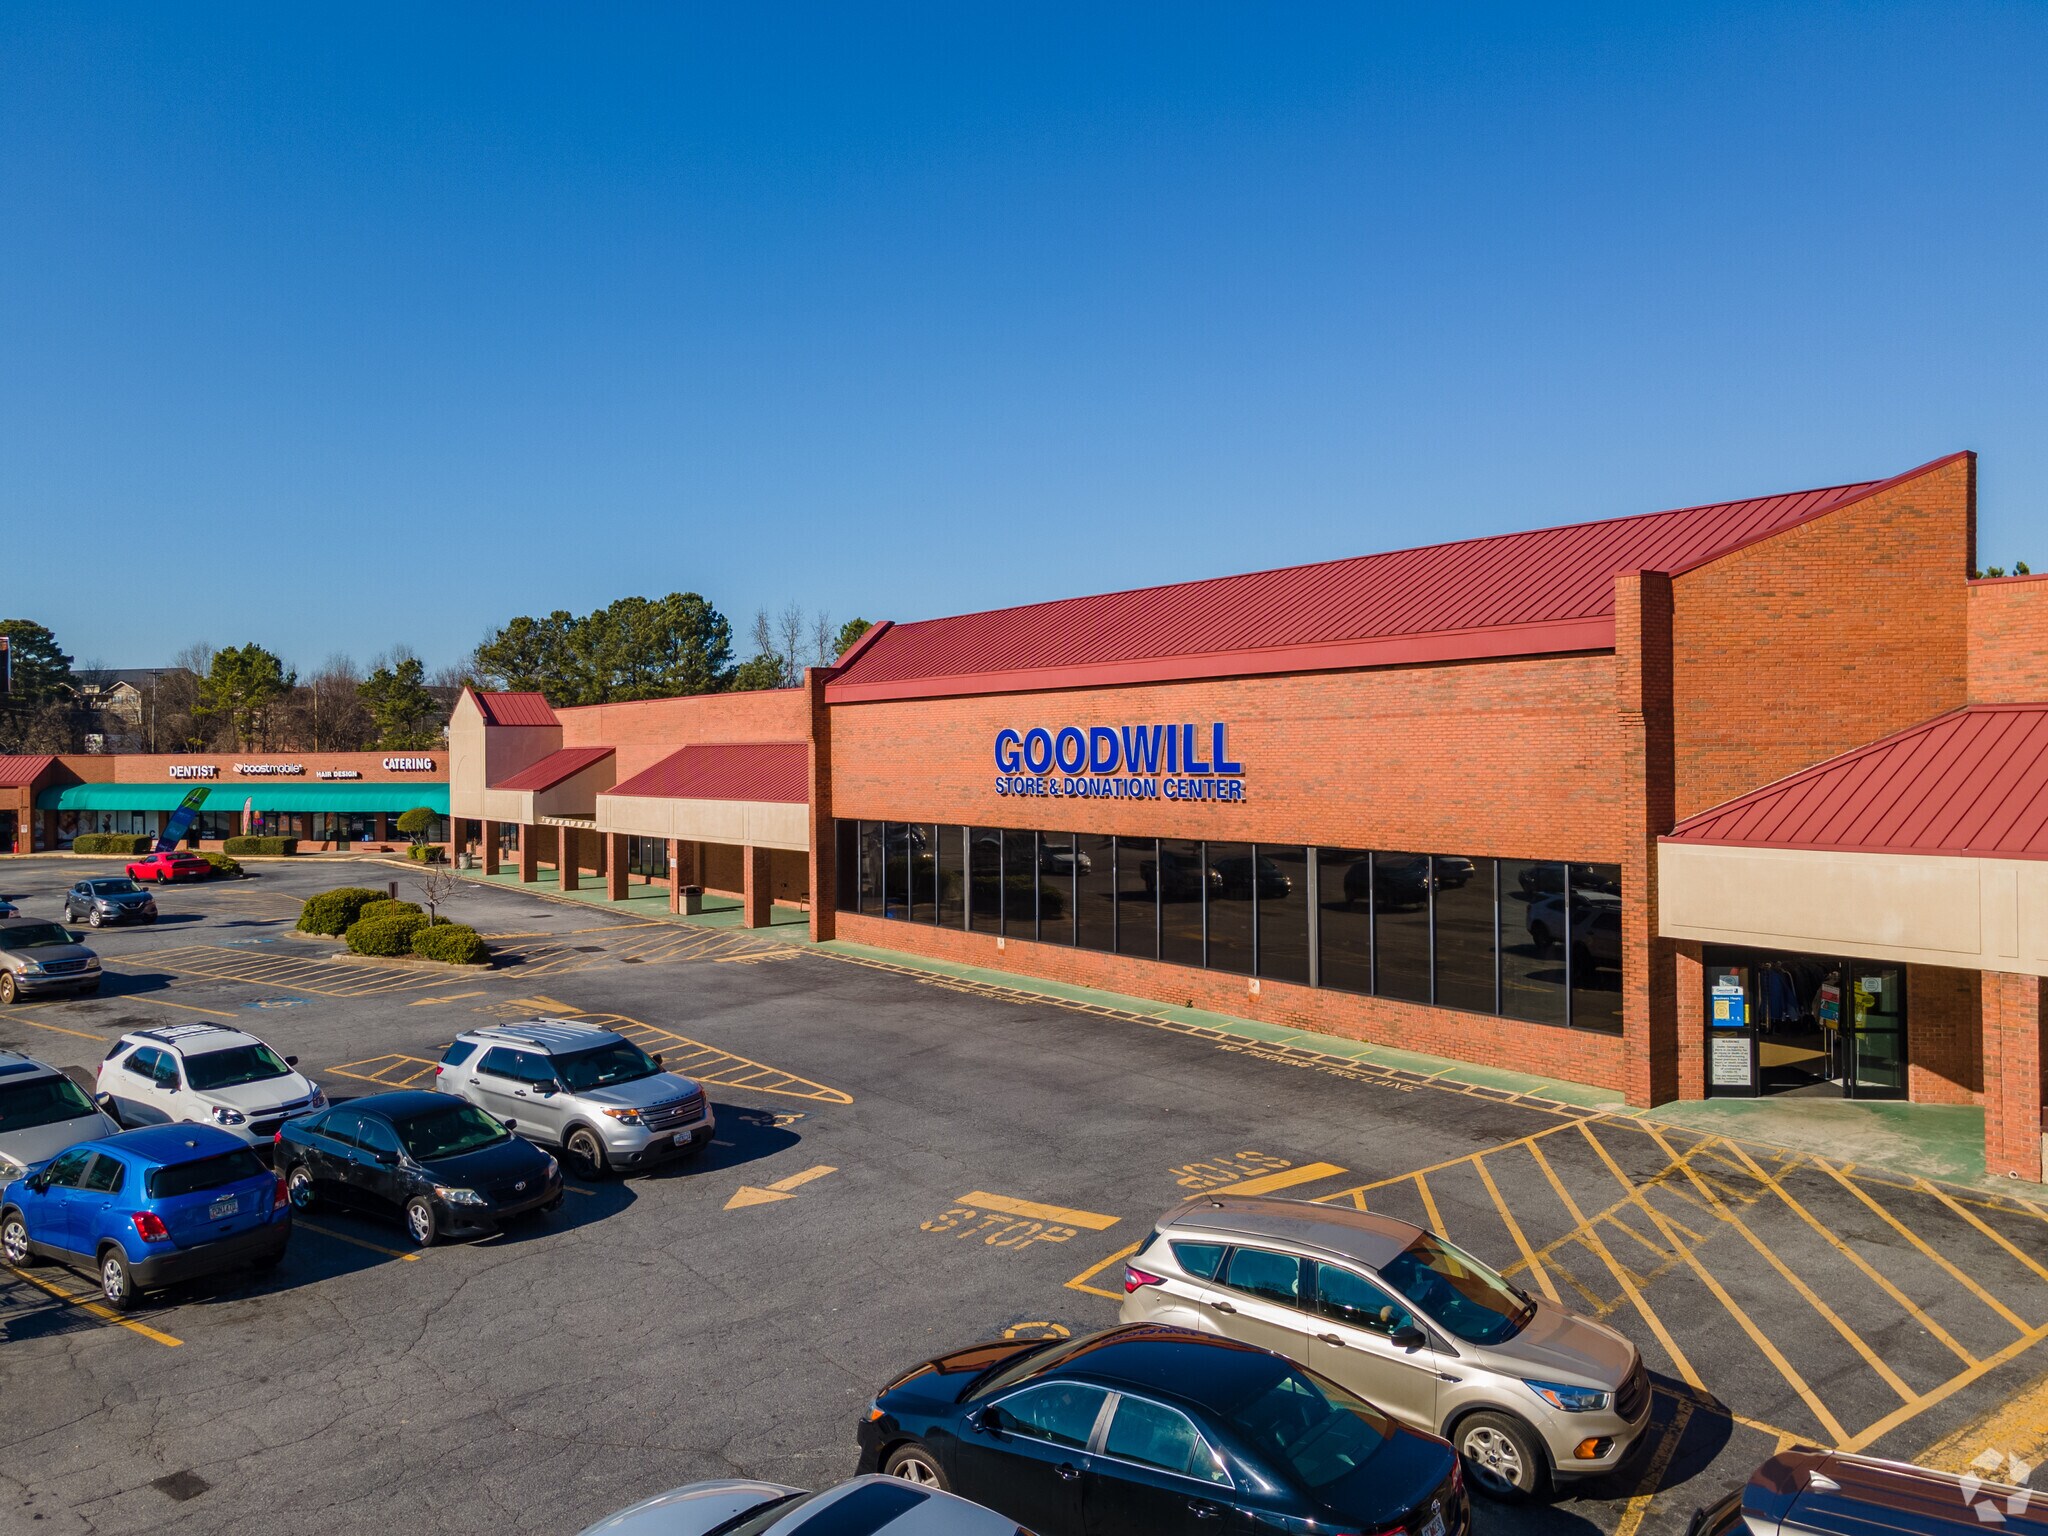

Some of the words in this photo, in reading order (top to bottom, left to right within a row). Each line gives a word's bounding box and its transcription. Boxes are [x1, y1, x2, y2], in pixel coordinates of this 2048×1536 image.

[382, 758, 432, 769] CATERING
[994, 722, 1244, 775] GOODWILL
[169, 765, 216, 777] DENTIST
[333, 770, 358, 778] DESIGN
[995, 777, 1045, 795] STORE
[1049, 778, 1060, 795] &
[1064, 778, 1157, 797] DONATION
[1163, 778, 1243, 799] CENTER
[1215, 1044, 1242, 1052] NO
[1241, 1050, 1315, 1068] PARKING
[1315, 1066, 1366, 1080] FIRE
[1361, 1077, 1423, 1093] LANE
[1168, 1151, 1292, 1189] STOP
[920, 1208, 1078, 1251] STOP
